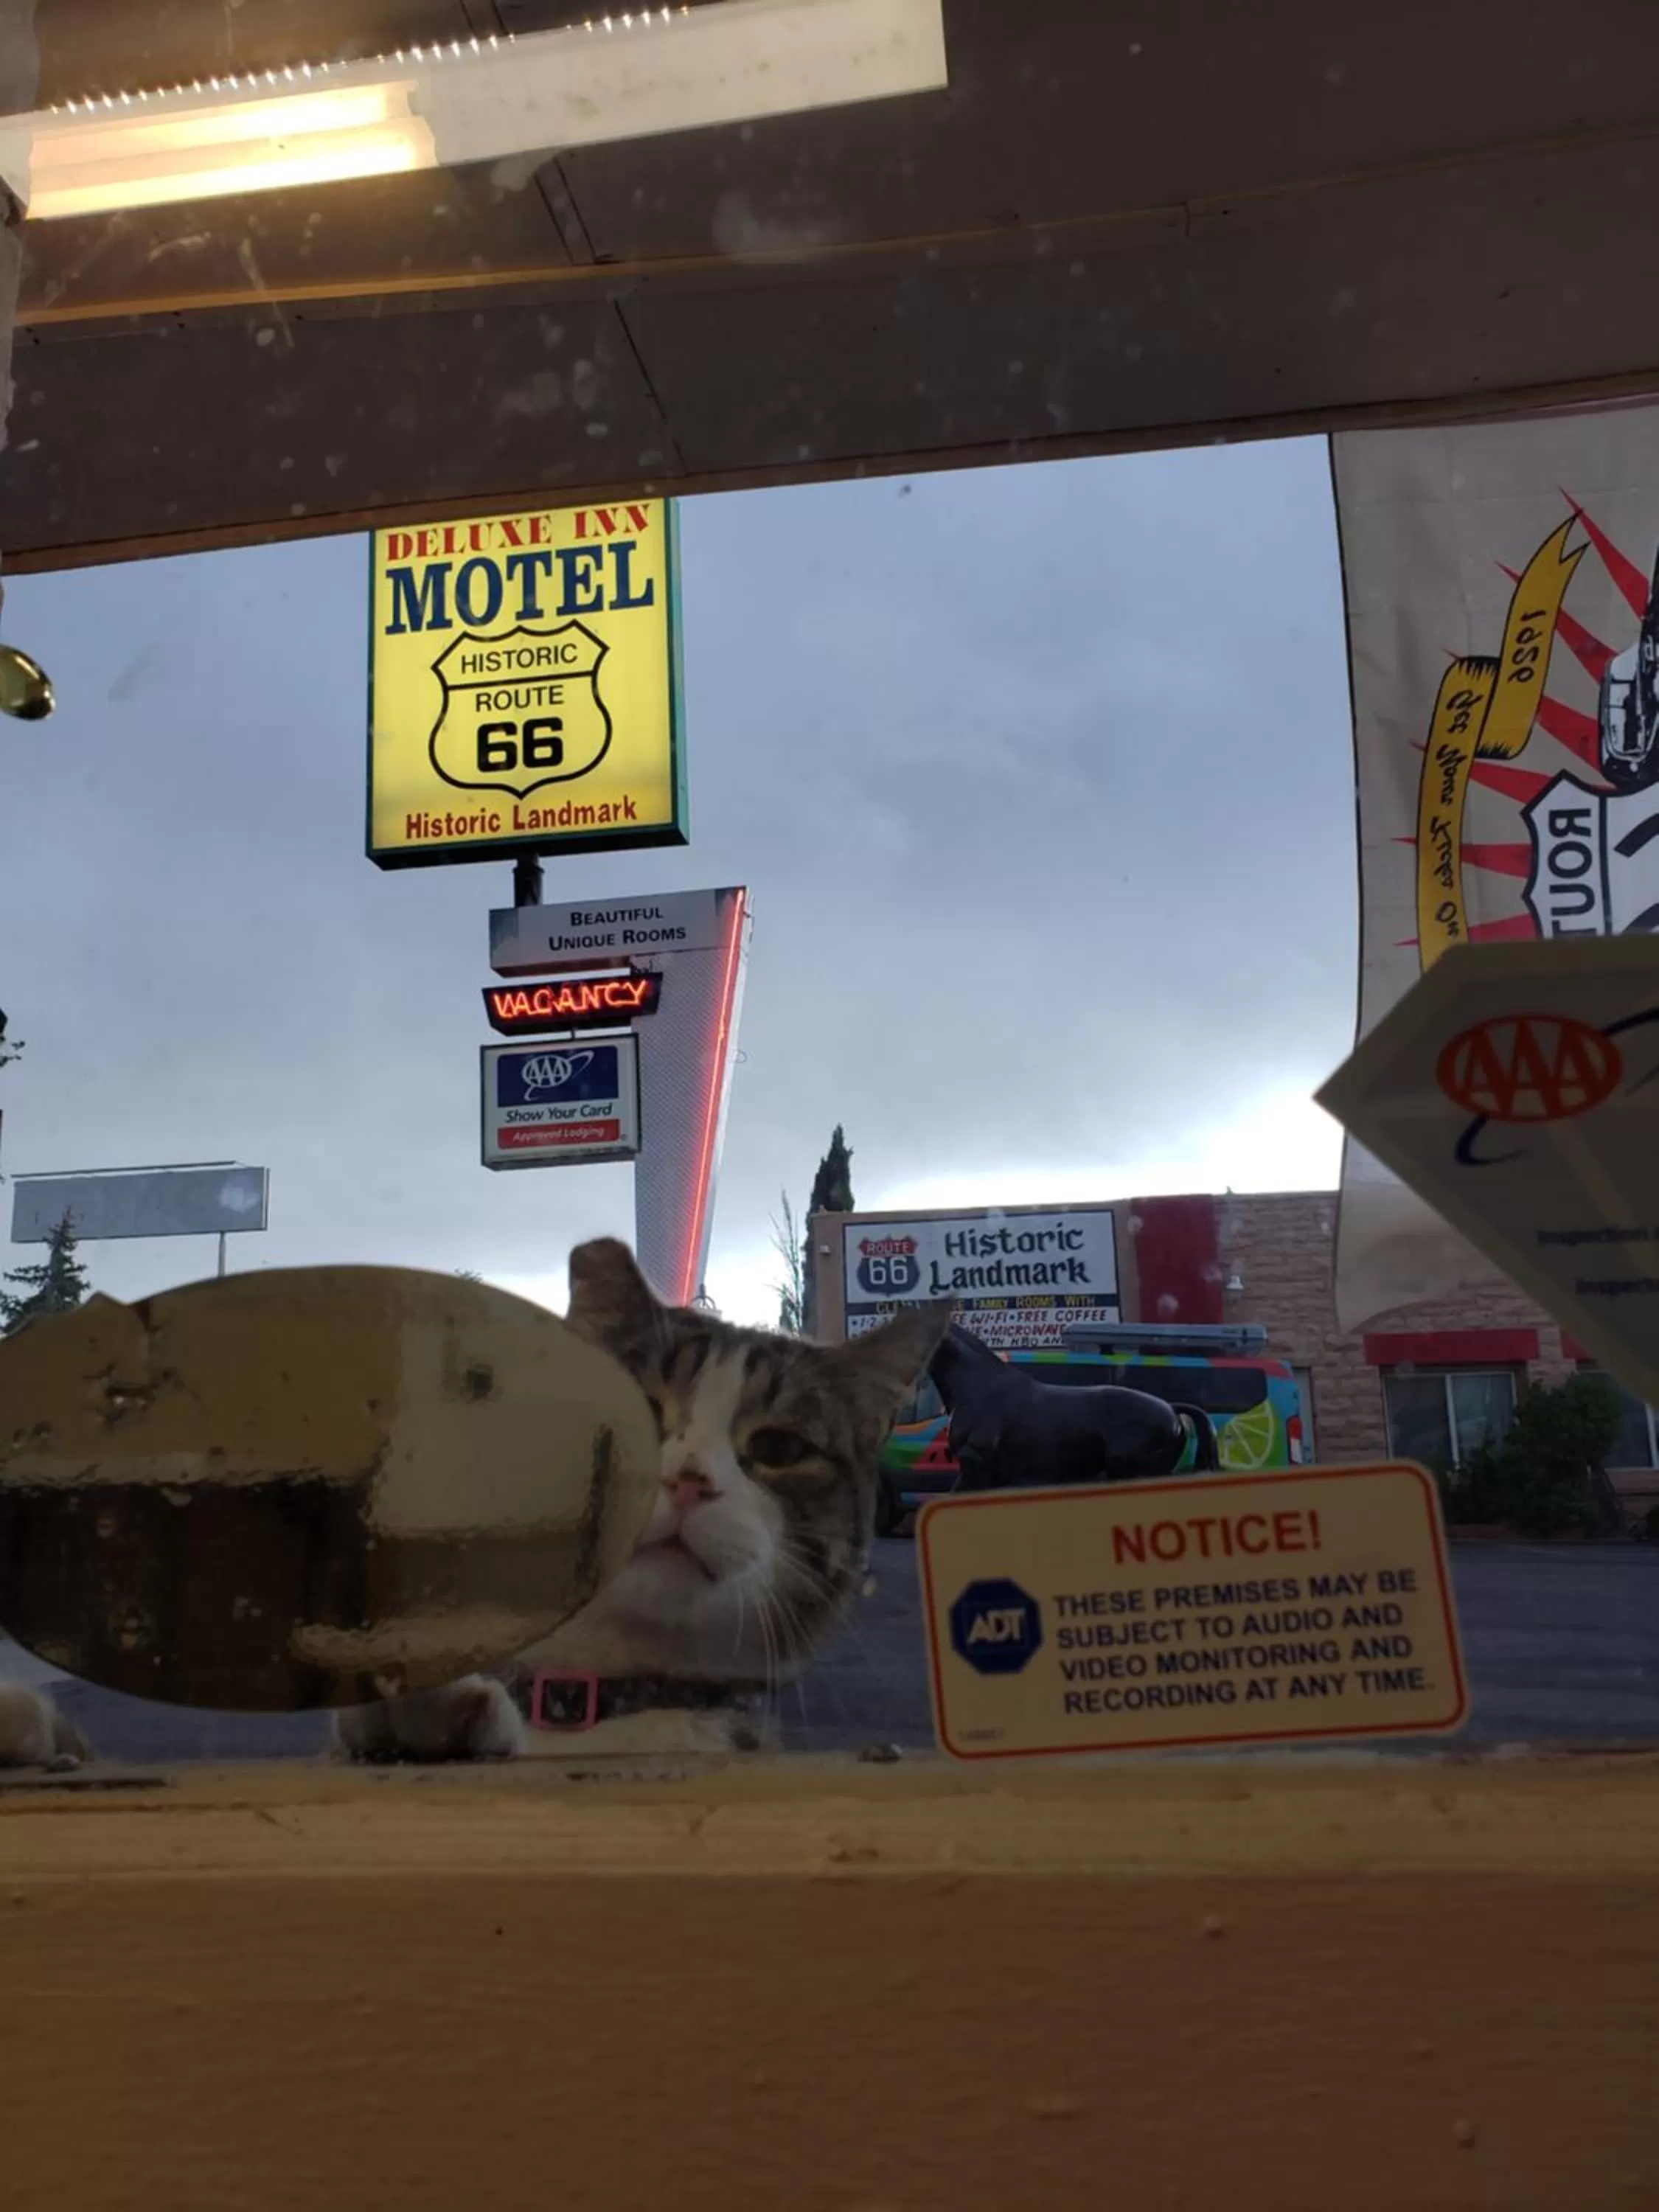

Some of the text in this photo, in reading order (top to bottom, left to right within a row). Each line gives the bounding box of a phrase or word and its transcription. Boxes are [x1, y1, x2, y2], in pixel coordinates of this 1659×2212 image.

[386, 504, 650, 561] DELUXE INN
[385, 540, 655, 636] MOTEL
[461, 643, 578, 675] HISTORIC
[475, 685, 565, 712] ROUTE
[477, 716, 563, 773] 66
[406, 795, 637, 839] Historic Landmark
[570, 906, 665, 928] BEAUTIFUL
[549, 926, 686, 952] UNIQUE ROOMS
[493, 979, 649, 1018] VACANCY
[524, 1056, 570, 1088] AAA
[1442, 1016, 1613, 1121] AAA
[505, 1102, 613, 1124] Show Your Card
[866, 1240, 910, 1255] ROUTE
[945, 1222, 1085, 1259] Historic
[868, 1256, 908, 1285] 66
[929, 1256, 1091, 1296] Landmark
[1015, 1295, 1057, 1308] ROOMS
[1064, 1295, 1096, 1307] WITH
[1017, 1310, 1048, 1322] FREE
[1055, 1309, 1107, 1322] COFFEE
[1110, 1509, 1323, 1565] NOTICE!
[1051, 1568, 1418, 1618] THESE PREMISES MAY BE
[966, 1607, 1025, 1646] ADT
[1057, 1603, 1402, 1649] SUBJECT TO AUDIO AND
[1060, 1635, 1413, 1683] VIDEO MONITORING AND
[1064, 1667, 1435, 1715] RECORDING AT ANY TIME.
